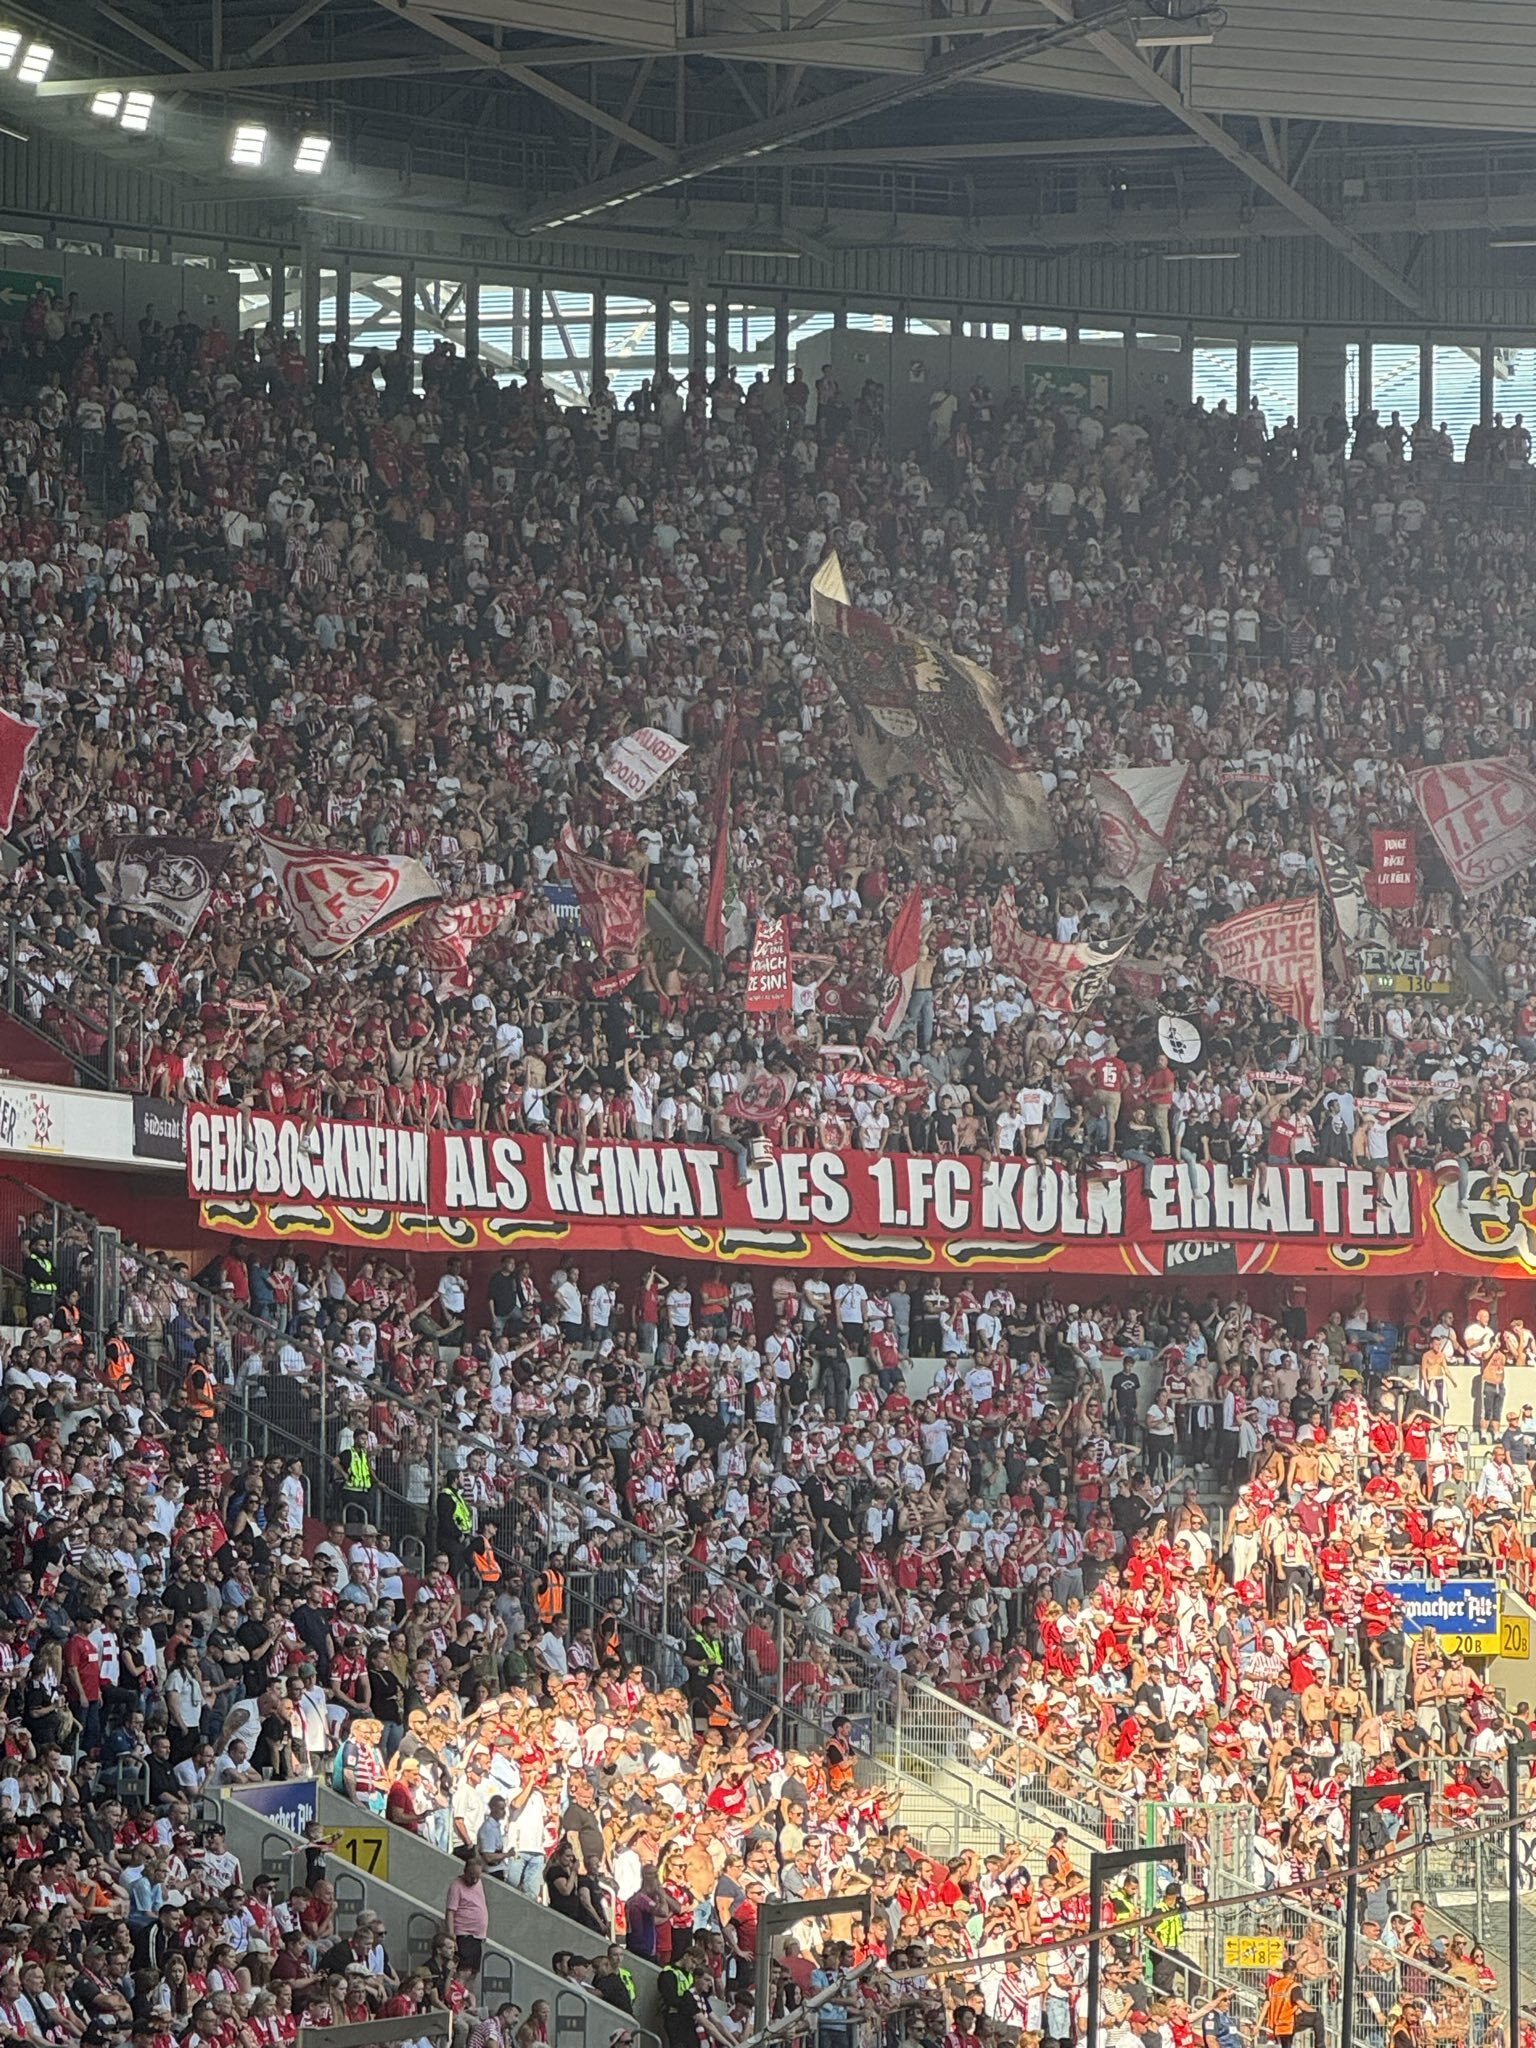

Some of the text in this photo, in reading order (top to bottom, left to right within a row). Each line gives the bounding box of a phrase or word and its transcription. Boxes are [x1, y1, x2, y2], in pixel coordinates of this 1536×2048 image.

[0, 1096, 17, 1148] ER
[445, 1136, 528, 1211] ALS
[543, 1142, 719, 1216] HEIMAT
[746, 1152, 849, 1223] DES
[868, 1157, 971, 1229] 1.FC
[982, 1158, 1122, 1235] KÖLN
[1150, 1163, 1411, 1235] ERHALTEN
[1402, 1596, 1493, 1620] macher Alt
[346, 1838, 382, 1874] 17
